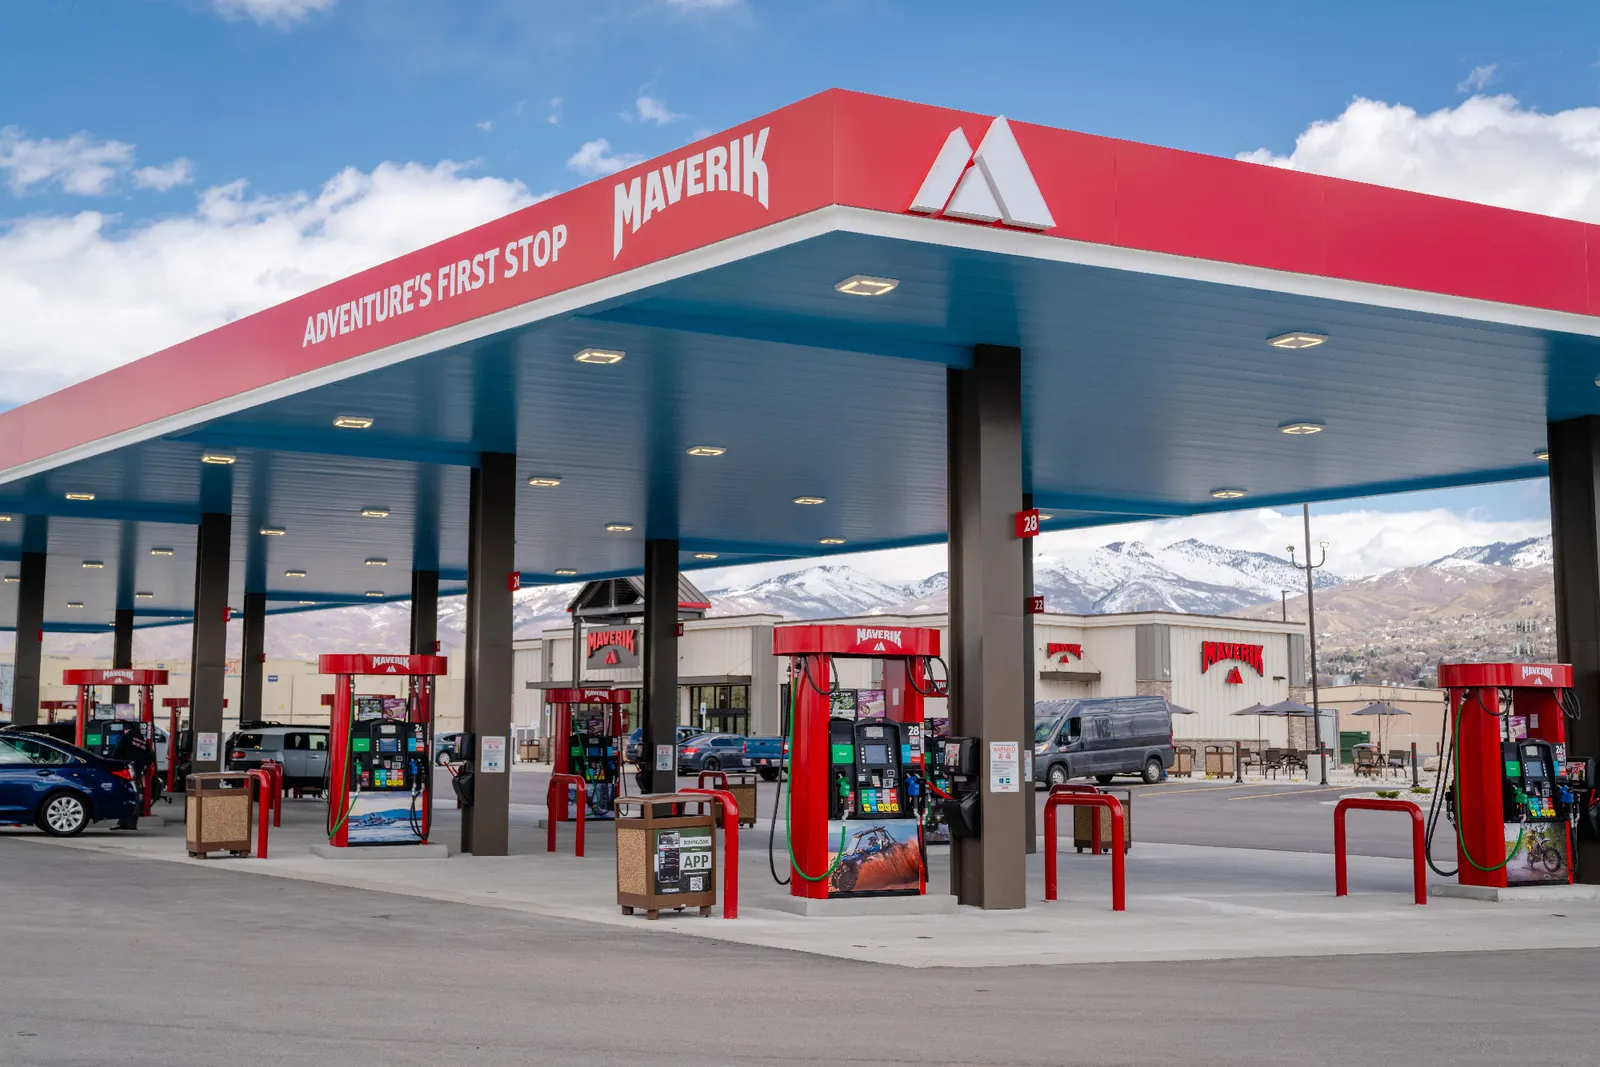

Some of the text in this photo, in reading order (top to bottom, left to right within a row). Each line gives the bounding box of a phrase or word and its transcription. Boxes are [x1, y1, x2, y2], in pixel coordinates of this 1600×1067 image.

[613, 127, 770, 260] MAVERIK
[302, 224, 567, 347] ADVENTURE'S FIRST STOP
[1023, 515, 1038, 532] 28
[513, 575, 520, 588] 24
[587, 629, 635, 658] MAVERIK
[857, 628, 902, 648] MAVERIK
[372, 656, 410, 670] MAVERIK
[1201, 641, 1264, 677] MAVERIK
[103, 670, 134, 680] MAVERIK
[1522, 666, 1553, 682] MAVERIK
[584, 690, 609, 699] MAVERIK
[908, 726, 919, 735] 28
[1555, 745, 1563, 753] 26
[683, 854, 709, 868] APP
